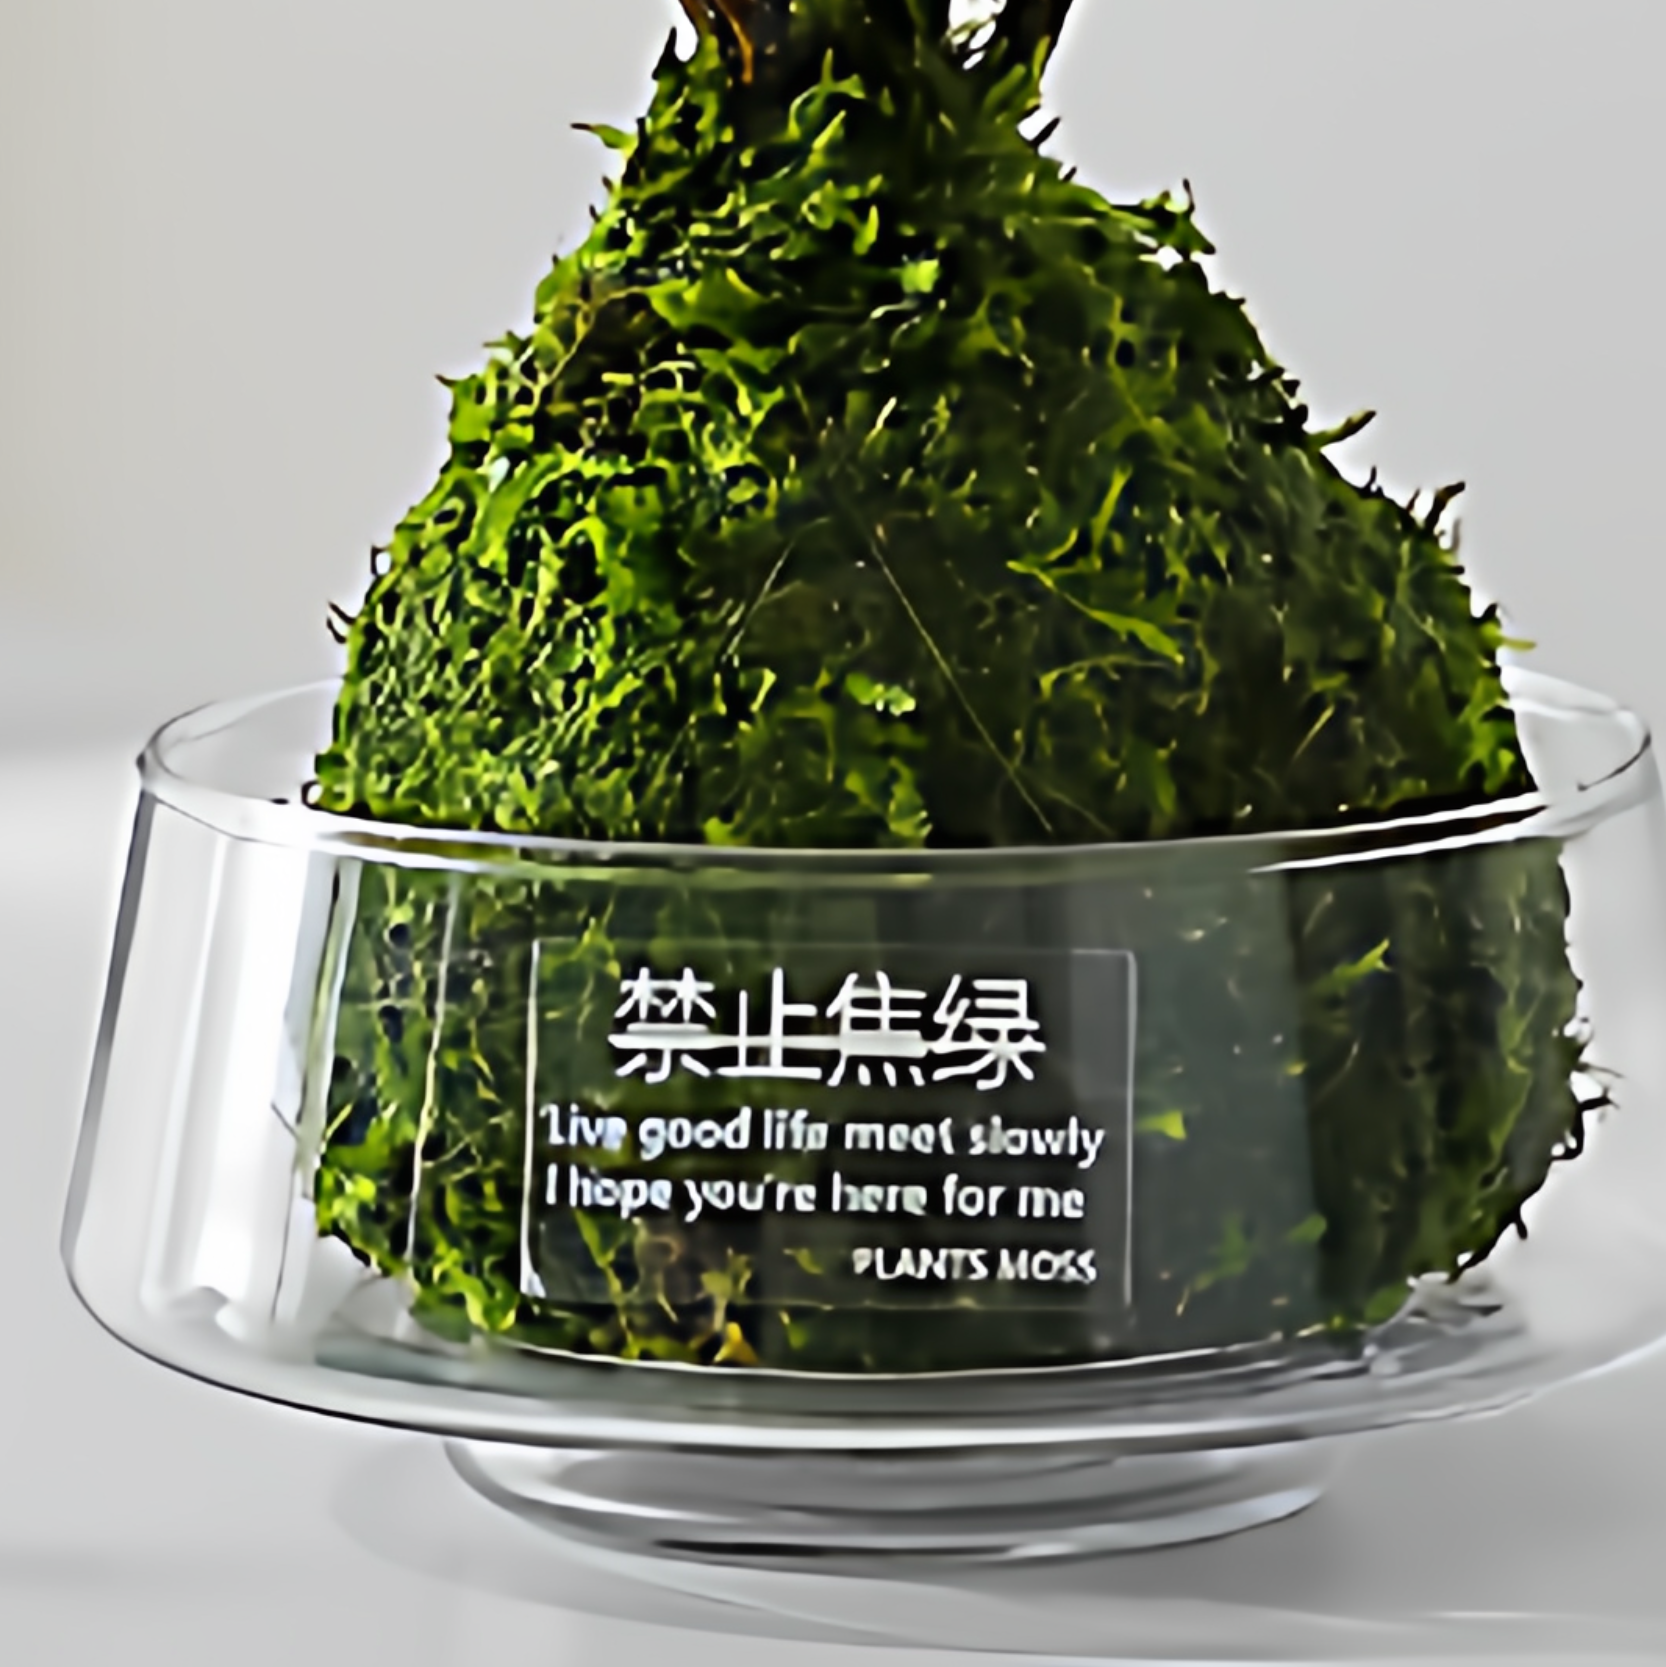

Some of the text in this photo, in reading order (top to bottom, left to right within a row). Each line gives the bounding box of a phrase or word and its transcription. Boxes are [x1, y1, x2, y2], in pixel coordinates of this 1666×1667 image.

[607, 966, 1047, 1090] 禁止焦绿
[638, 1105, 753, 1161] good
[969, 1116, 1106, 1168] slowly
[545, 1163, 1085, 1222] I hope you're here for me
[851, 1247, 1097, 1284] PLANTS MOSS
